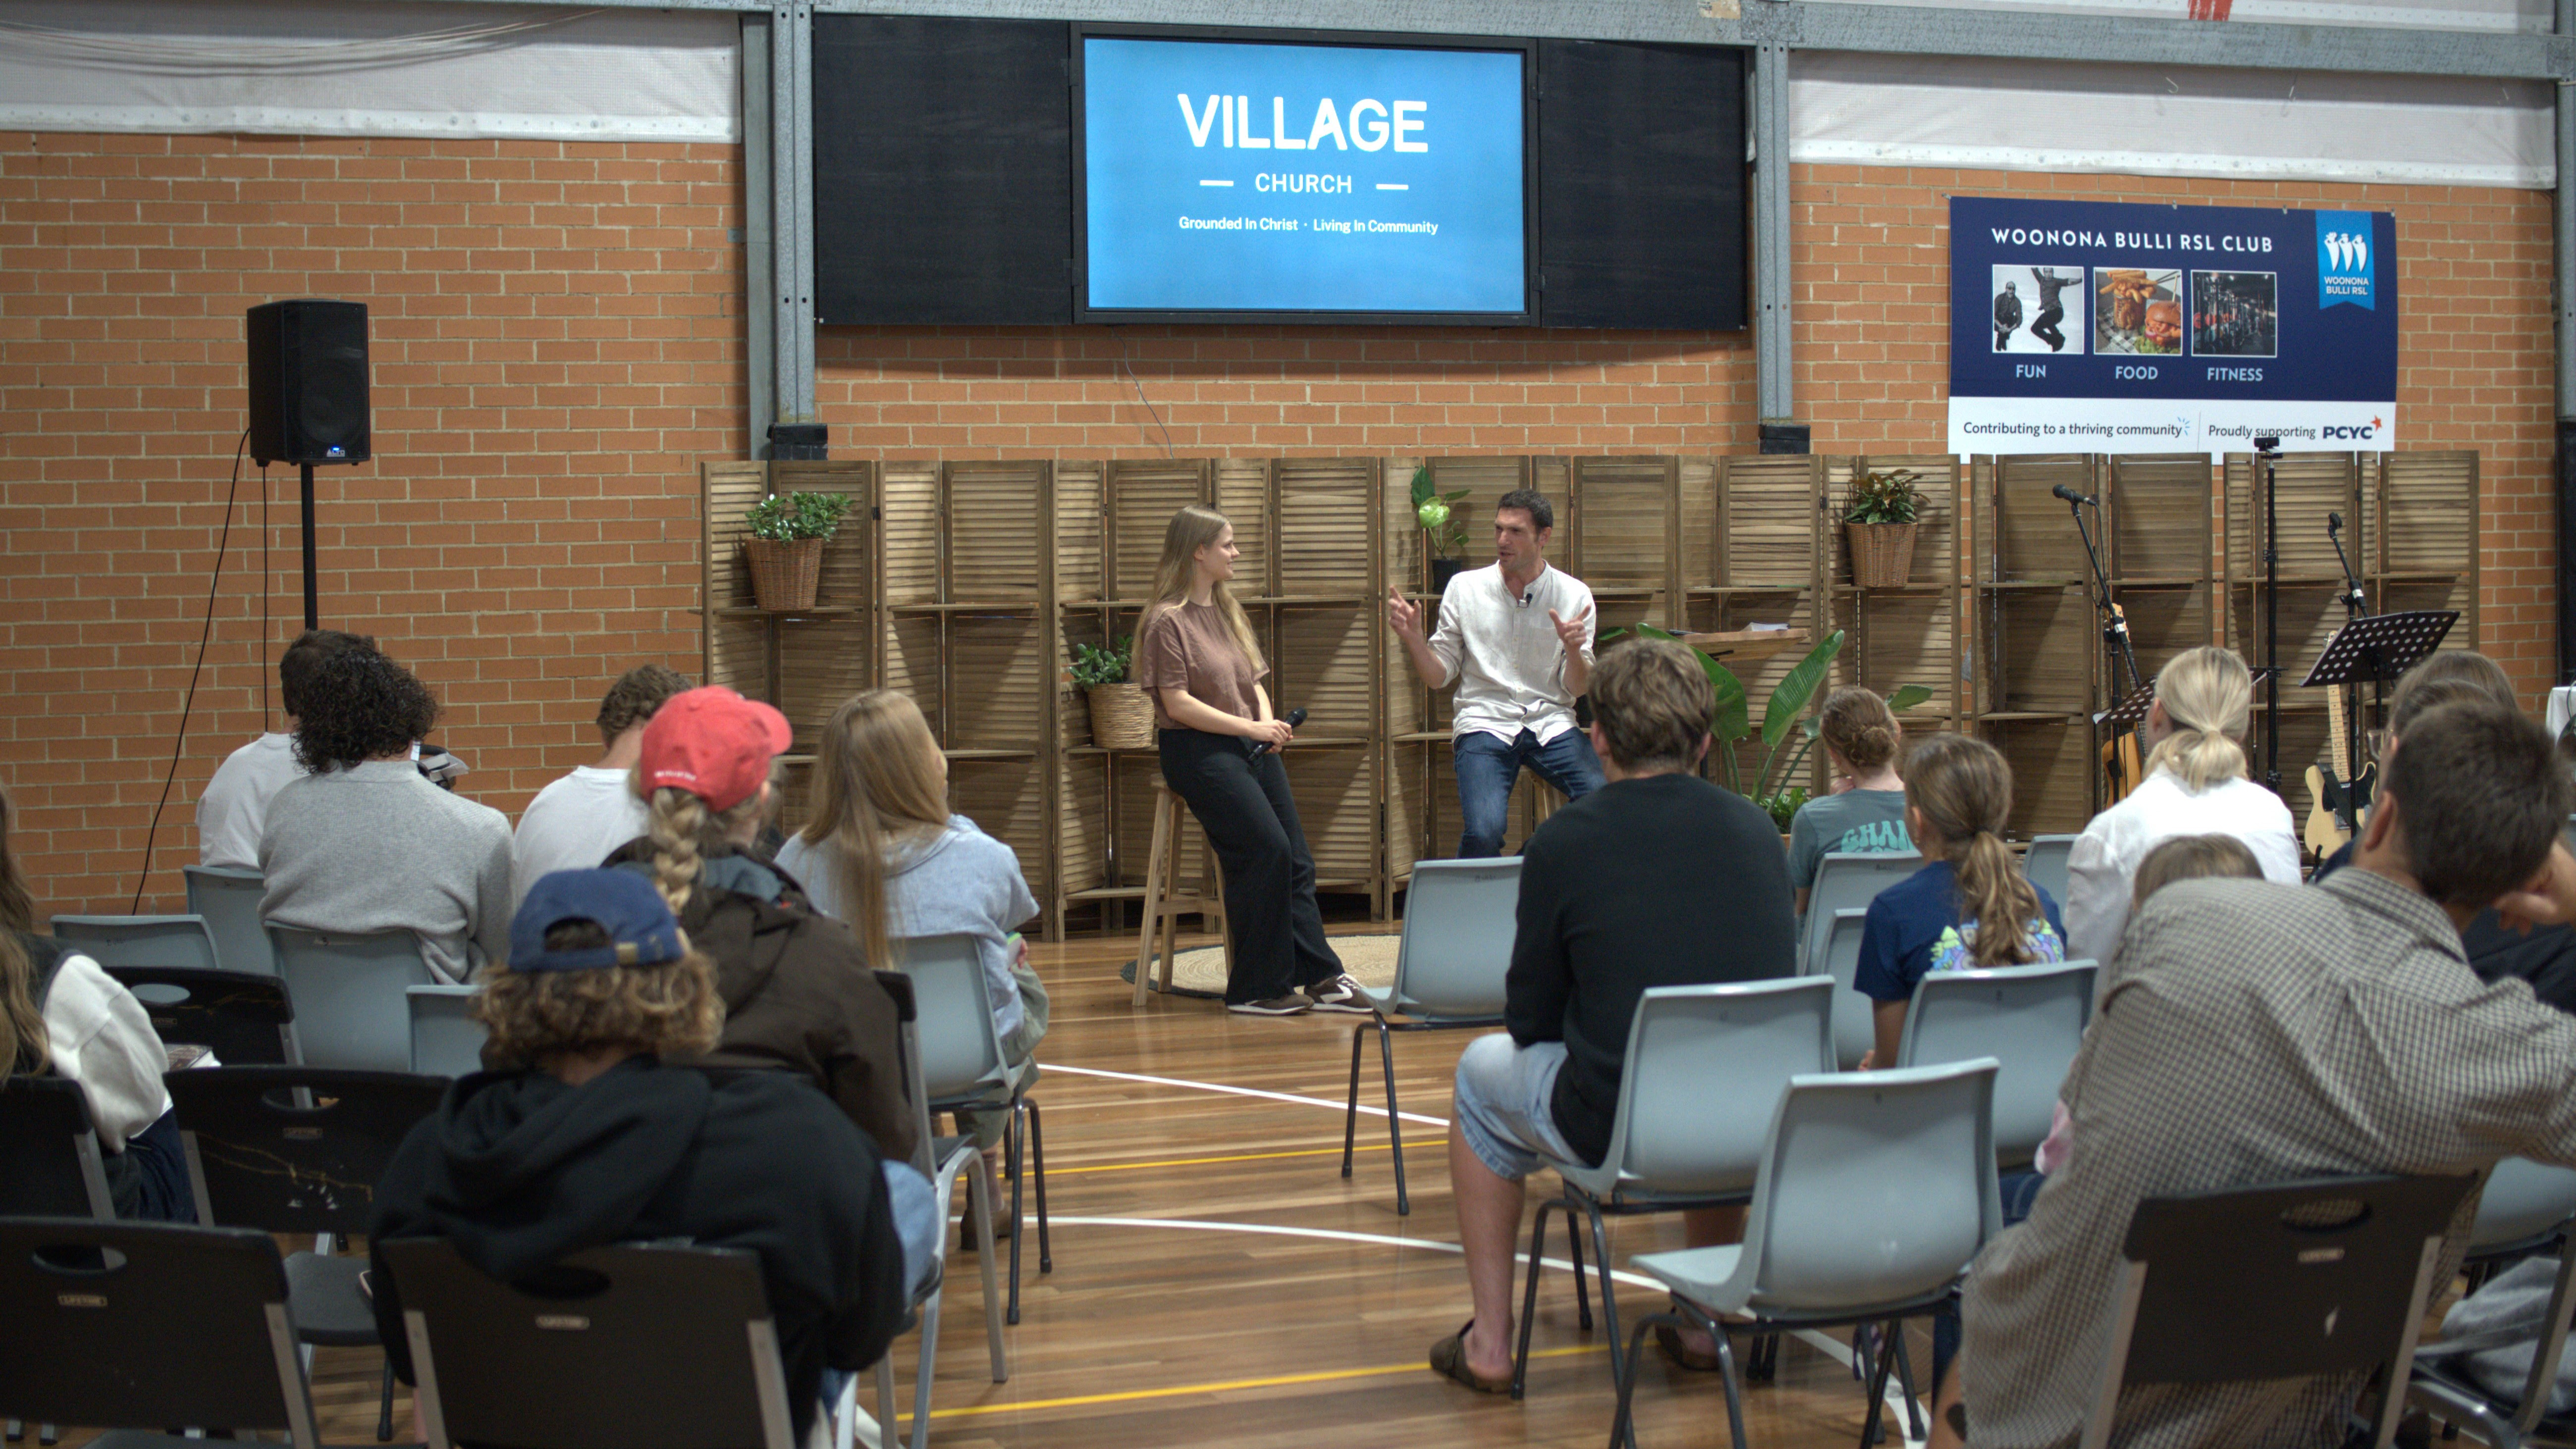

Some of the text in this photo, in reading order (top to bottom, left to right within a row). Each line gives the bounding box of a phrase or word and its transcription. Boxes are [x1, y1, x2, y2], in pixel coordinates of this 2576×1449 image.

[1177, 93, 1428, 153] VILLAGE
[1255, 173, 1352, 194] CHURCH
[1179, 216, 1439, 235] Grounded In Christ Living In Community
[1991, 228, 2272, 252] WOONONA BULLI RSL CLUB
[2324, 276, 2369, 286] WOONONA
[2326, 285, 2368, 295] BULLI RSL
[2016, 364, 2046, 378] FUN
[2116, 365, 2158, 380] FOOD
[2207, 367, 2263, 382] FITNESS
[1964, 421, 2182, 438] Contributing to a thriving community
[2209, 425, 2372, 440] Proudly supporting PCYC
